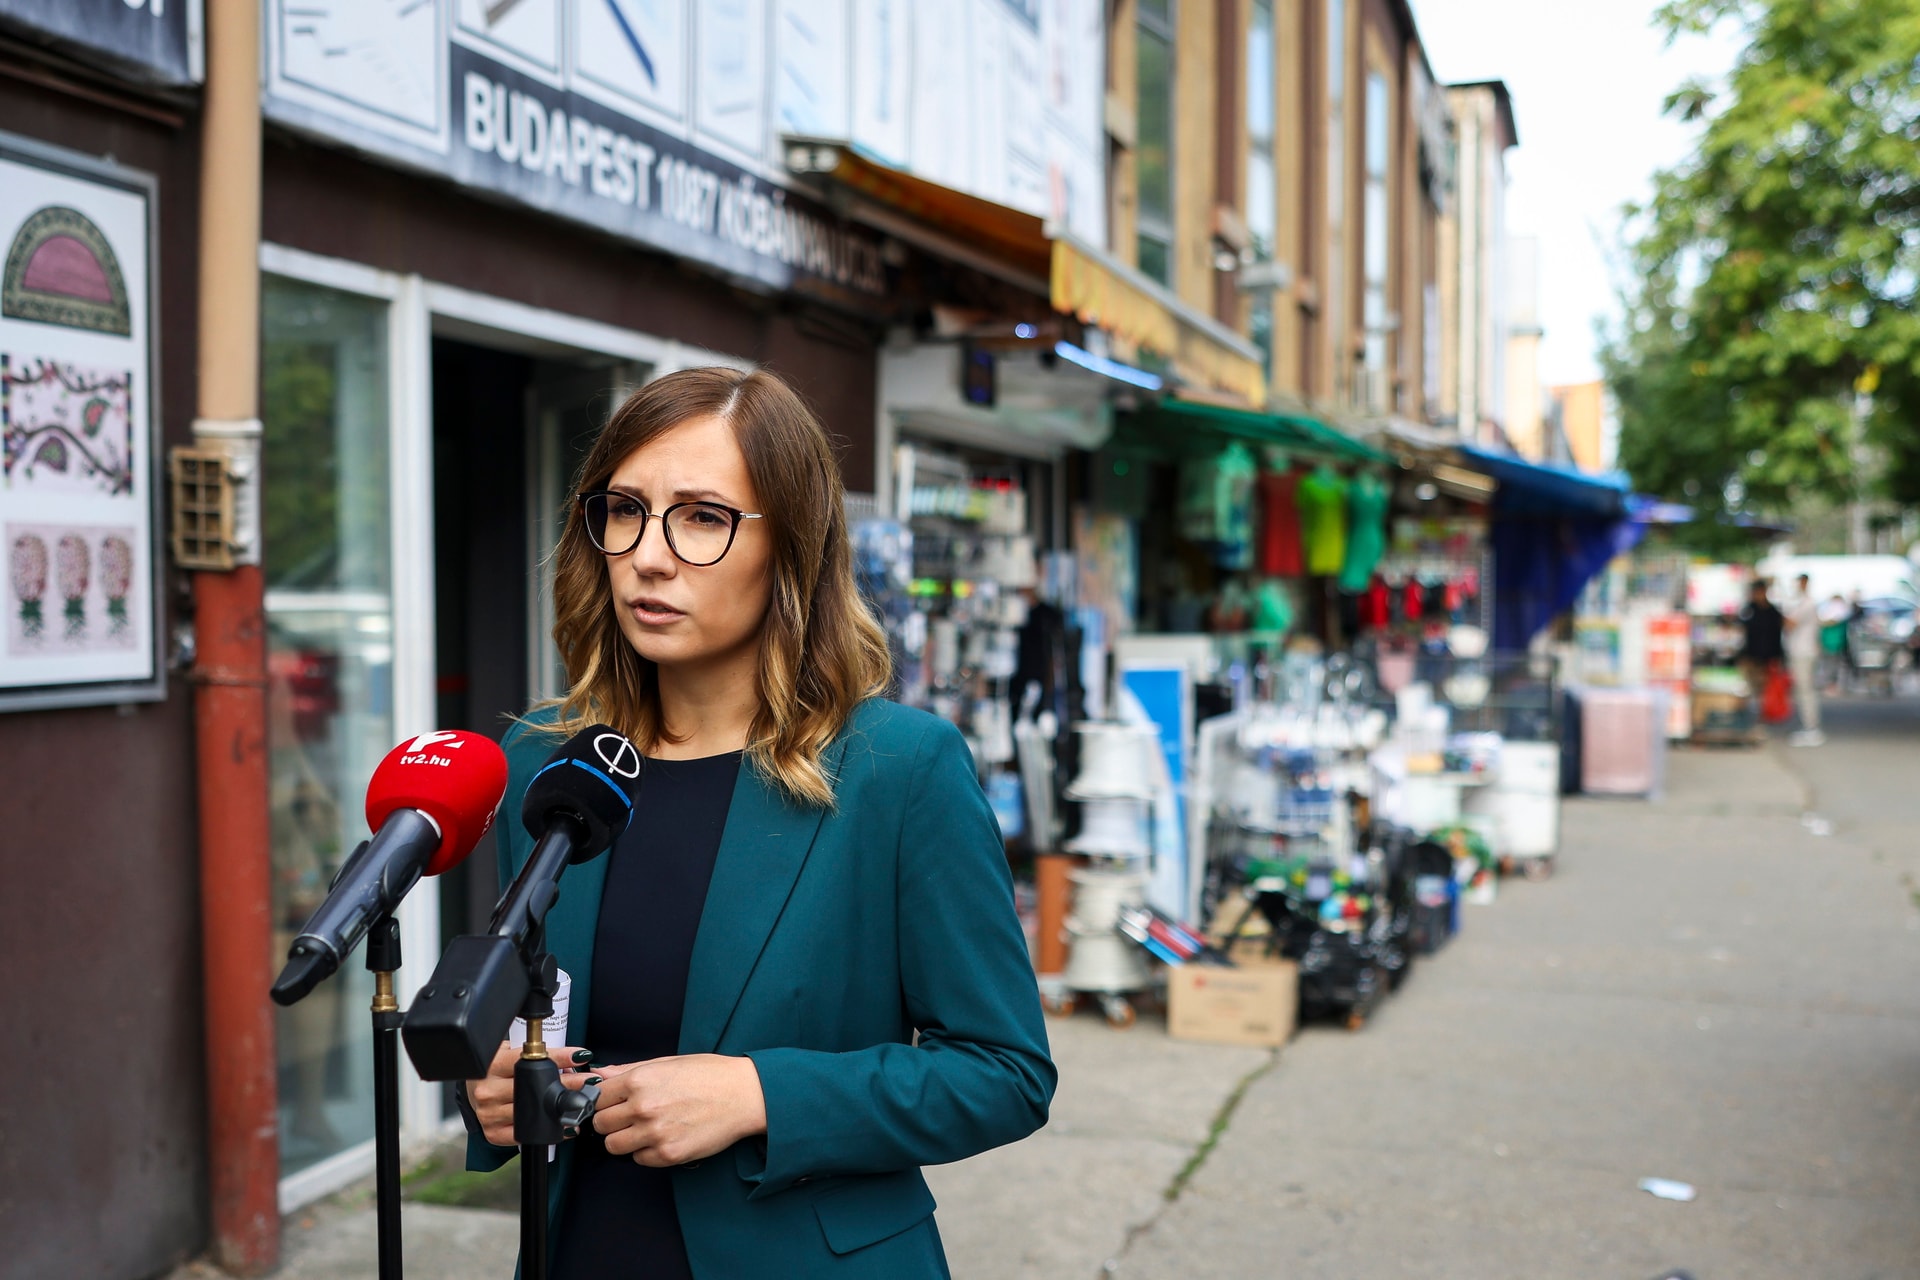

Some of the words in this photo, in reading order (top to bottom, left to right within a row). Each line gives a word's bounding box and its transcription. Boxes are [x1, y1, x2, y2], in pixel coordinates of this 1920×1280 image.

[465, 71, 656, 210] BUDAPEST
[656, 154, 719, 233] 1087
[400, 754, 451, 767] tv2.hu
